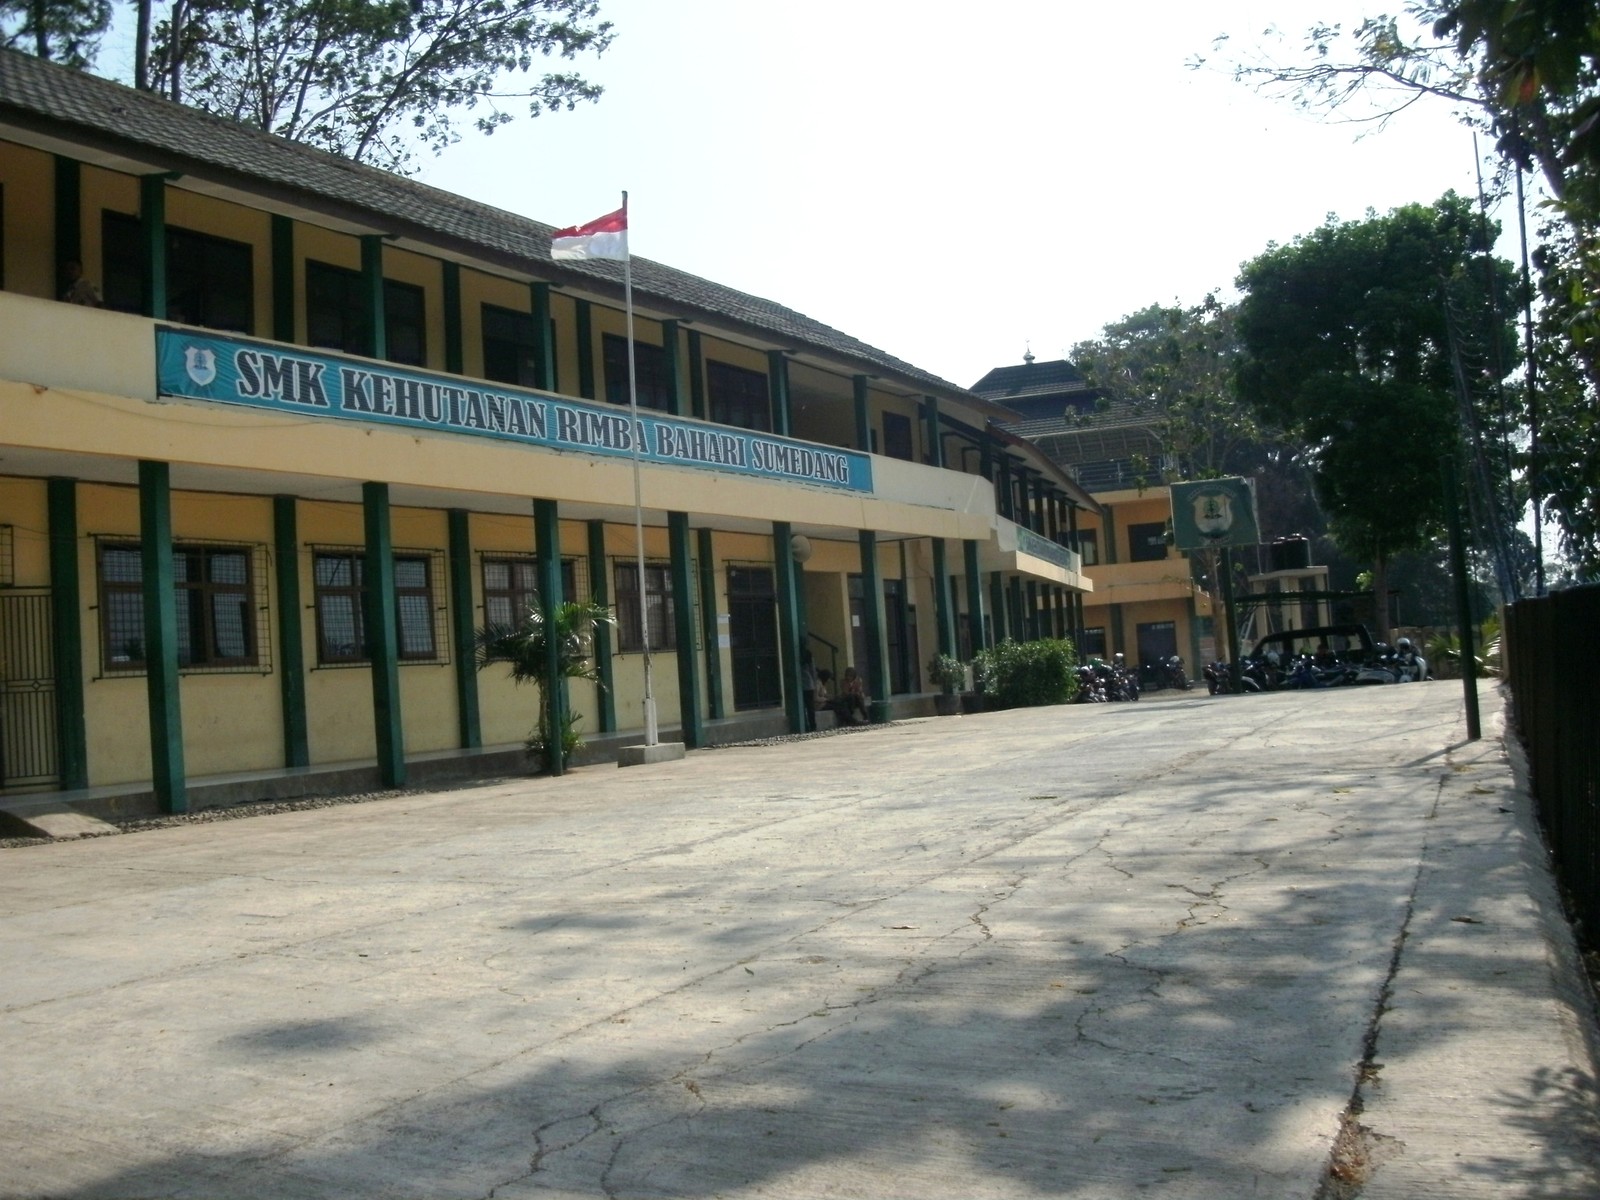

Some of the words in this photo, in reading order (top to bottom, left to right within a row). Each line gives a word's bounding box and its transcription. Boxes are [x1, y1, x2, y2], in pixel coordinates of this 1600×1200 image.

[236, 351, 330, 407] SMK
[341, 368, 547, 438] KEHUTANAN
[655, 423, 746, 468] BAHARI
[752, 441, 848, 484] SUMEDANG
